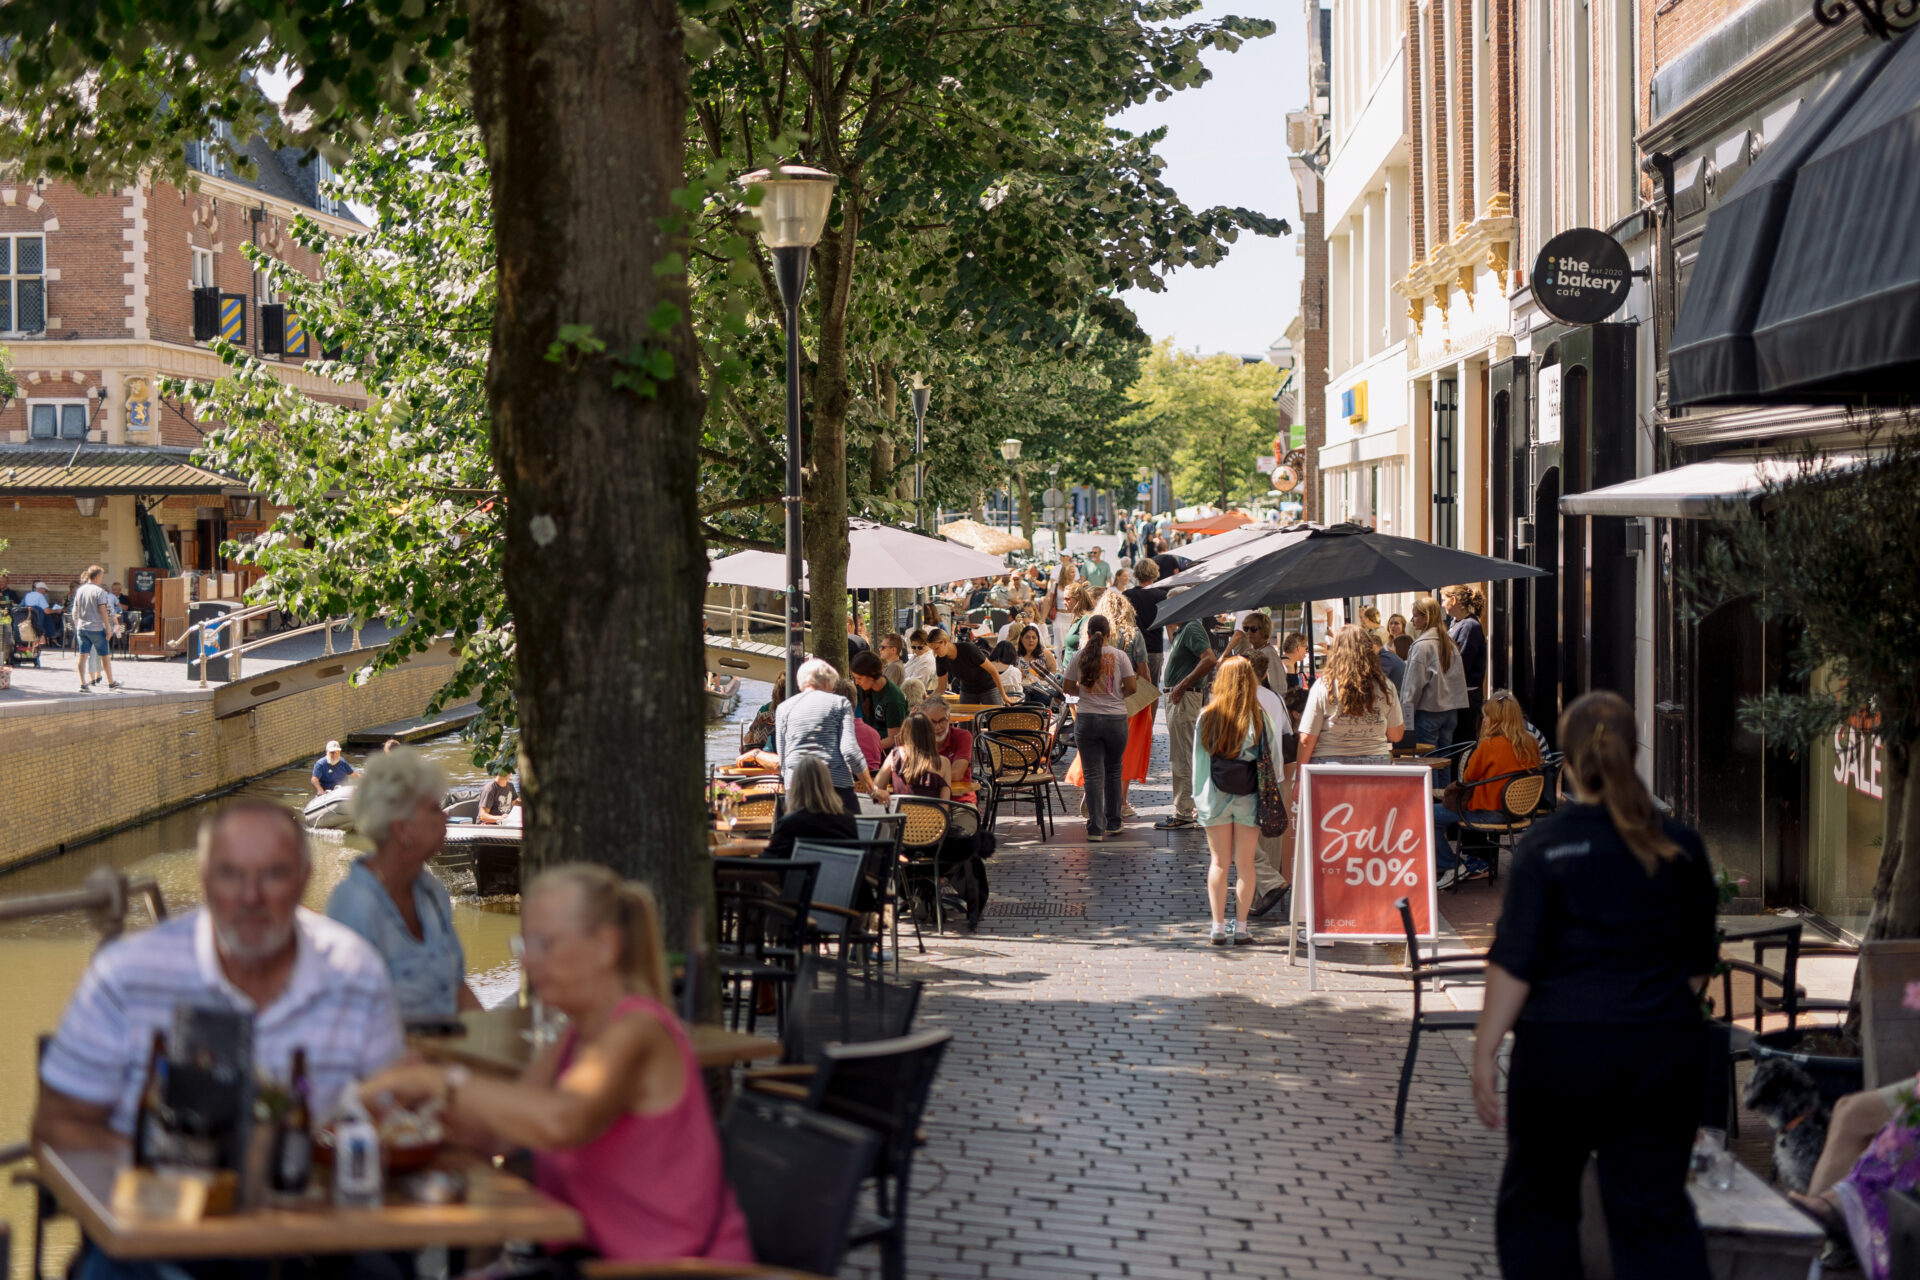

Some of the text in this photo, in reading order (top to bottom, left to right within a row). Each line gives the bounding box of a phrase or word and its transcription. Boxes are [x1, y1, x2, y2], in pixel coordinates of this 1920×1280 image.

[1559, 257, 1590, 271] the
[1556, 287, 1581, 297] café
[1558, 272, 1621, 294] bakery
[1833, 722, 1883, 800] SALE
[1320, 803, 1420, 863] Sale
[1345, 857, 1418, 886] 50%
[1324, 918, 1357, 927] BE ONE
